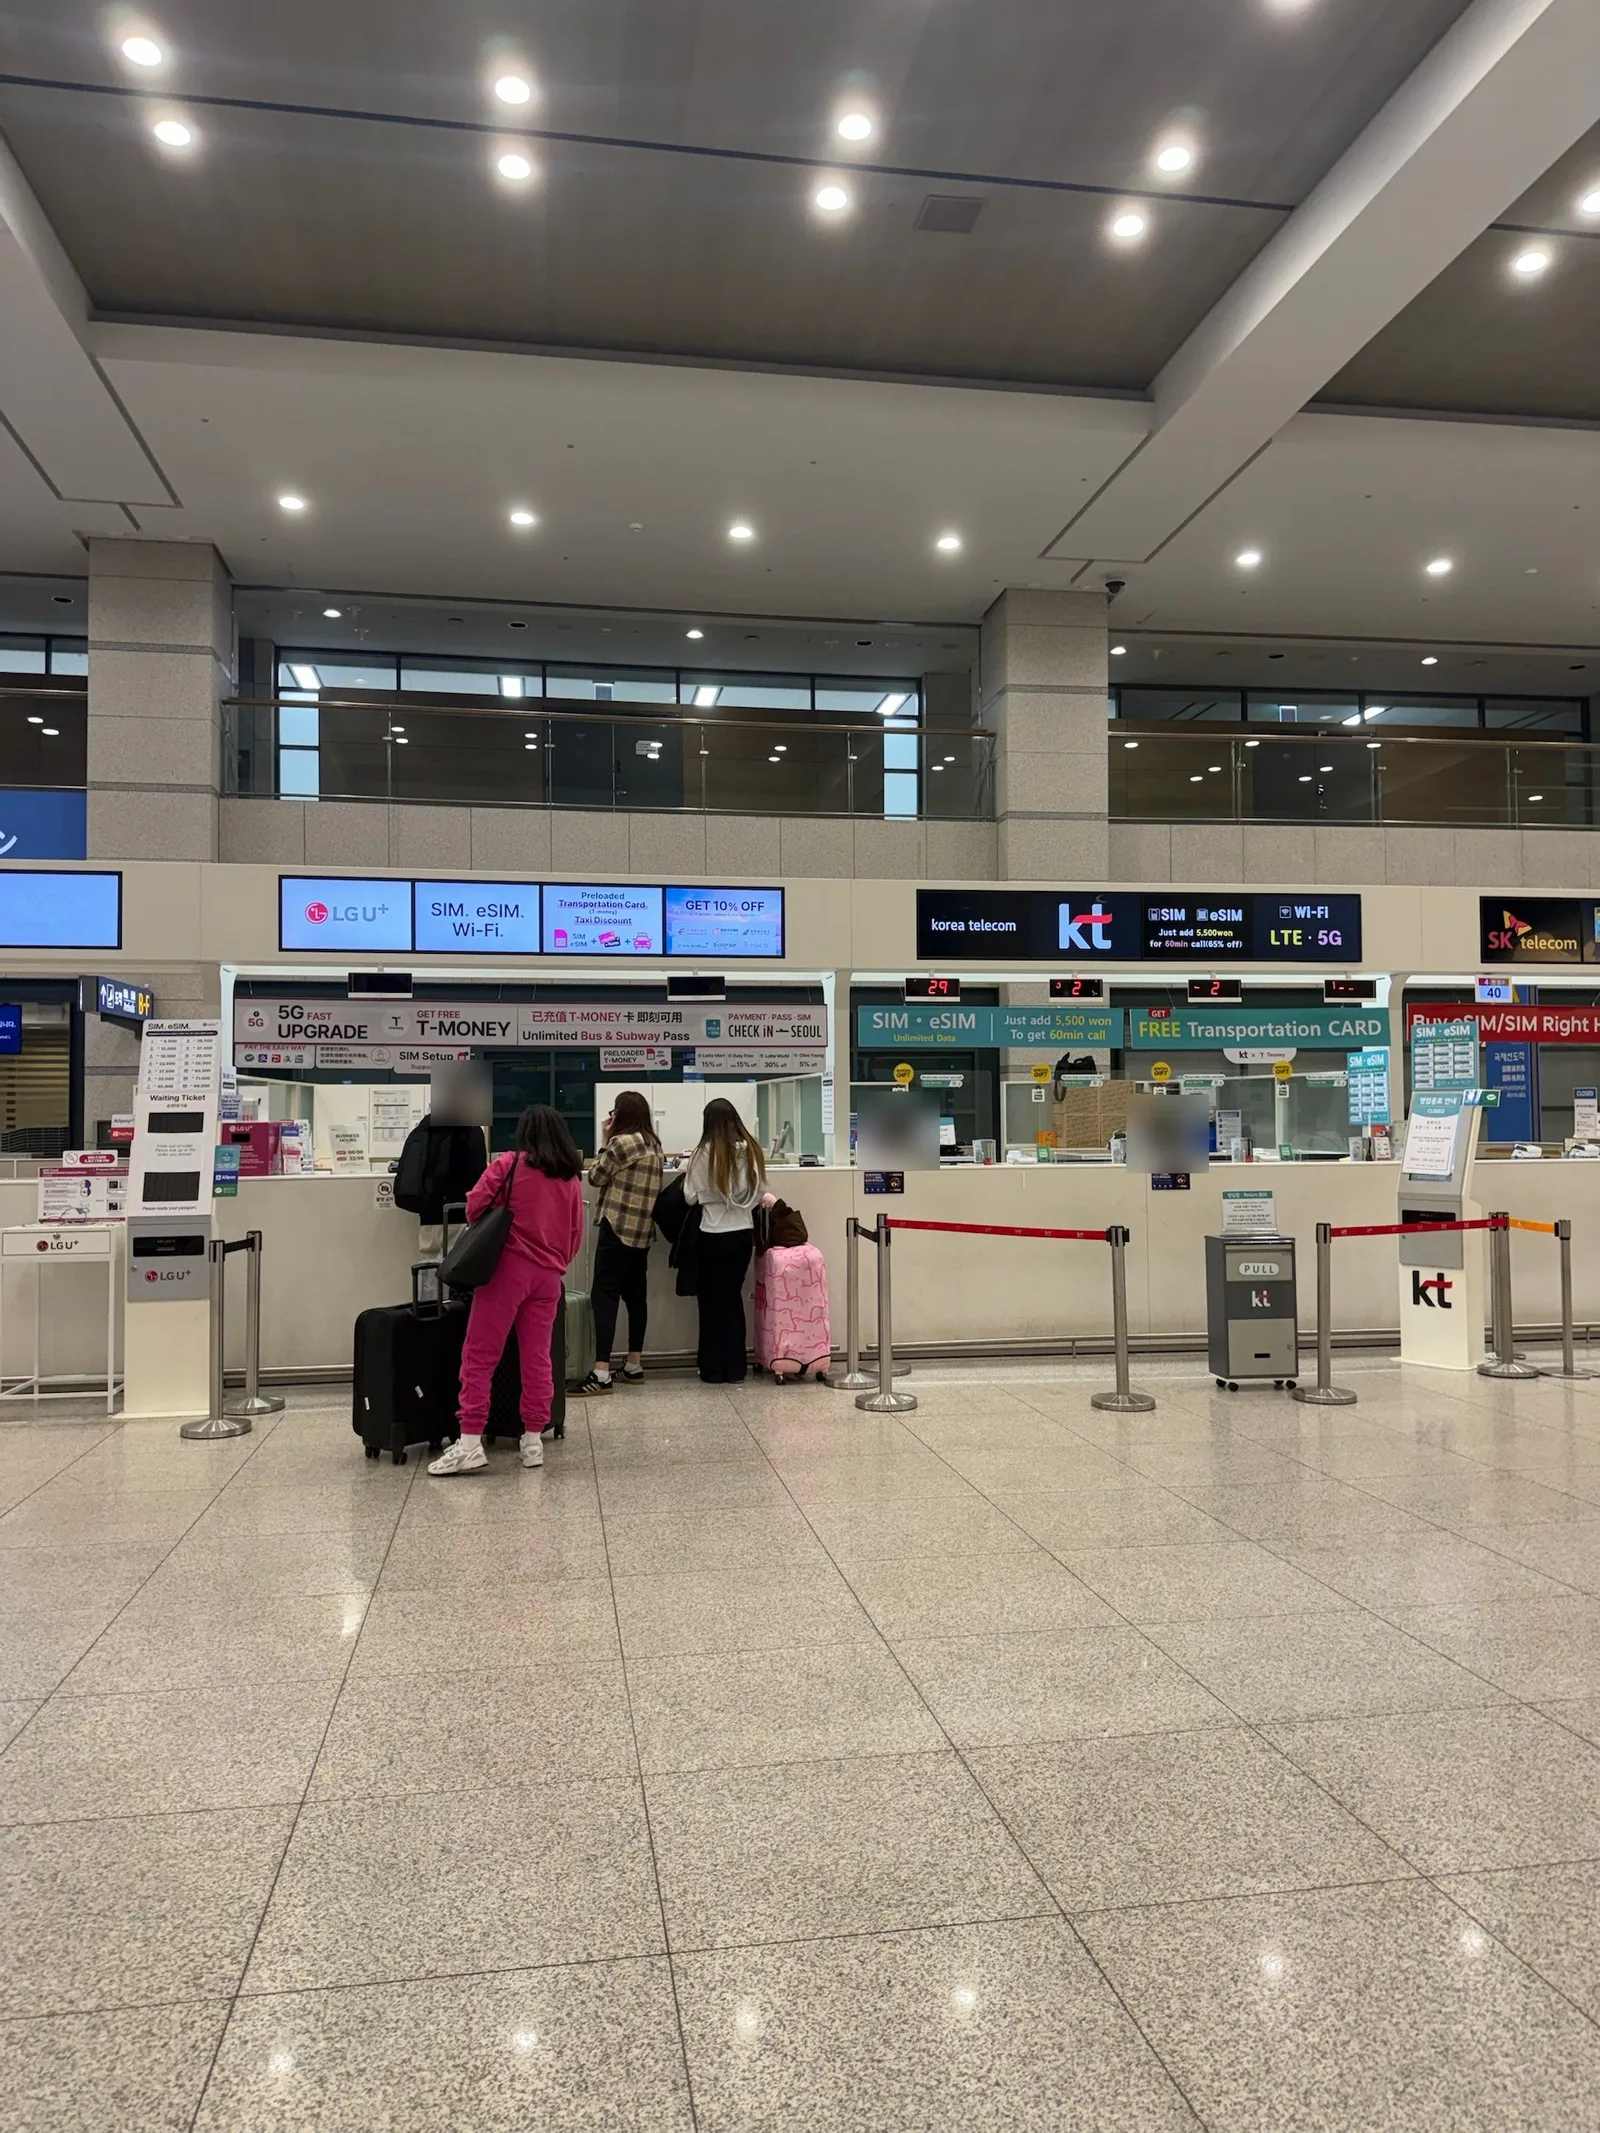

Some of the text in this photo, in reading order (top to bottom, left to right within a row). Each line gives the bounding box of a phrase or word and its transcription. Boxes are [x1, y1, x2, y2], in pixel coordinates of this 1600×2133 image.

[581, 892, 625, 900] Preloaded
[432, 902, 525, 919] SIM. eSIM.
[559, 900, 623, 910] Transportation
[686, 900, 765, 912] GET 10% OFF
[1161, 908, 1243, 922] SIM eSIM
[1294, 906, 1329, 919] Wi-Fi
[575, 916, 632, 925] Taxi Discount
[931, 919, 1017, 931] korea telecom
[1059, 903, 1113, 950] kt
[453, 922, 504, 937] Wi-Fi.
[1158, 929, 1234, 938] Just add 5,500won
[570, 940, 588, 948] eSIM
[1150, 939, 1162, 948] for
[1165, 940, 1189, 948] 60min
[1270, 930, 1343, 947] LTE 5G
[1488, 931, 1577, 950] SK telecom
[928, 981, 948, 995] 29
[1487, 987, 1502, 999] 40
[278, 1005, 332, 1021] 5G FAST
[417, 1010, 461, 1019] GET FREE
[532, 1011, 683, 1024] 已充值 T-MONEY 卡 即刻可用
[1152, 1010, 1166, 1018] GET
[248, 1018, 264, 1027] 5G
[872, 1012, 976, 1030] SIM eSIM
[1004, 1015, 1112, 1028] Just add 5,500 won
[1544, 1016, 1589, 1037] Right
[278, 1024, 368, 1040] UPGRADE
[416, 1020, 511, 1037] T-MONEY
[728, 1025, 760, 1038] CHECK
[791, 1026, 822, 1039] SEOUL
[1140, 1020, 1382, 1041] FREE Transportation CARD
[1416, 1025, 1470, 1038] SIM eSIM
[523, 1030, 691, 1043] Unlimited Bus & Subway Pass
[894, 1034, 956, 1043] Unlimited Data
[1010, 1030, 1106, 1043] To get 60min call
[399, 1052, 420, 1061] SIM
[1239, 1051, 1249, 1059] kt
[1350, 1054, 1385, 1068] SIM eSIM
[1494, 1052, 1525, 1062] 국제선도착
[150, 1094, 206, 1103] Waiting Ticket
[1420, 1097, 1457, 1105] 영업종료 안내
[50, 1242, 64, 1250] LG
[1244, 1264, 1274, 1273] PULL
[160, 1271, 175, 1281] LG
[1412, 1270, 1453, 1309] kt
[1251, 1290, 1271, 1308] kt
